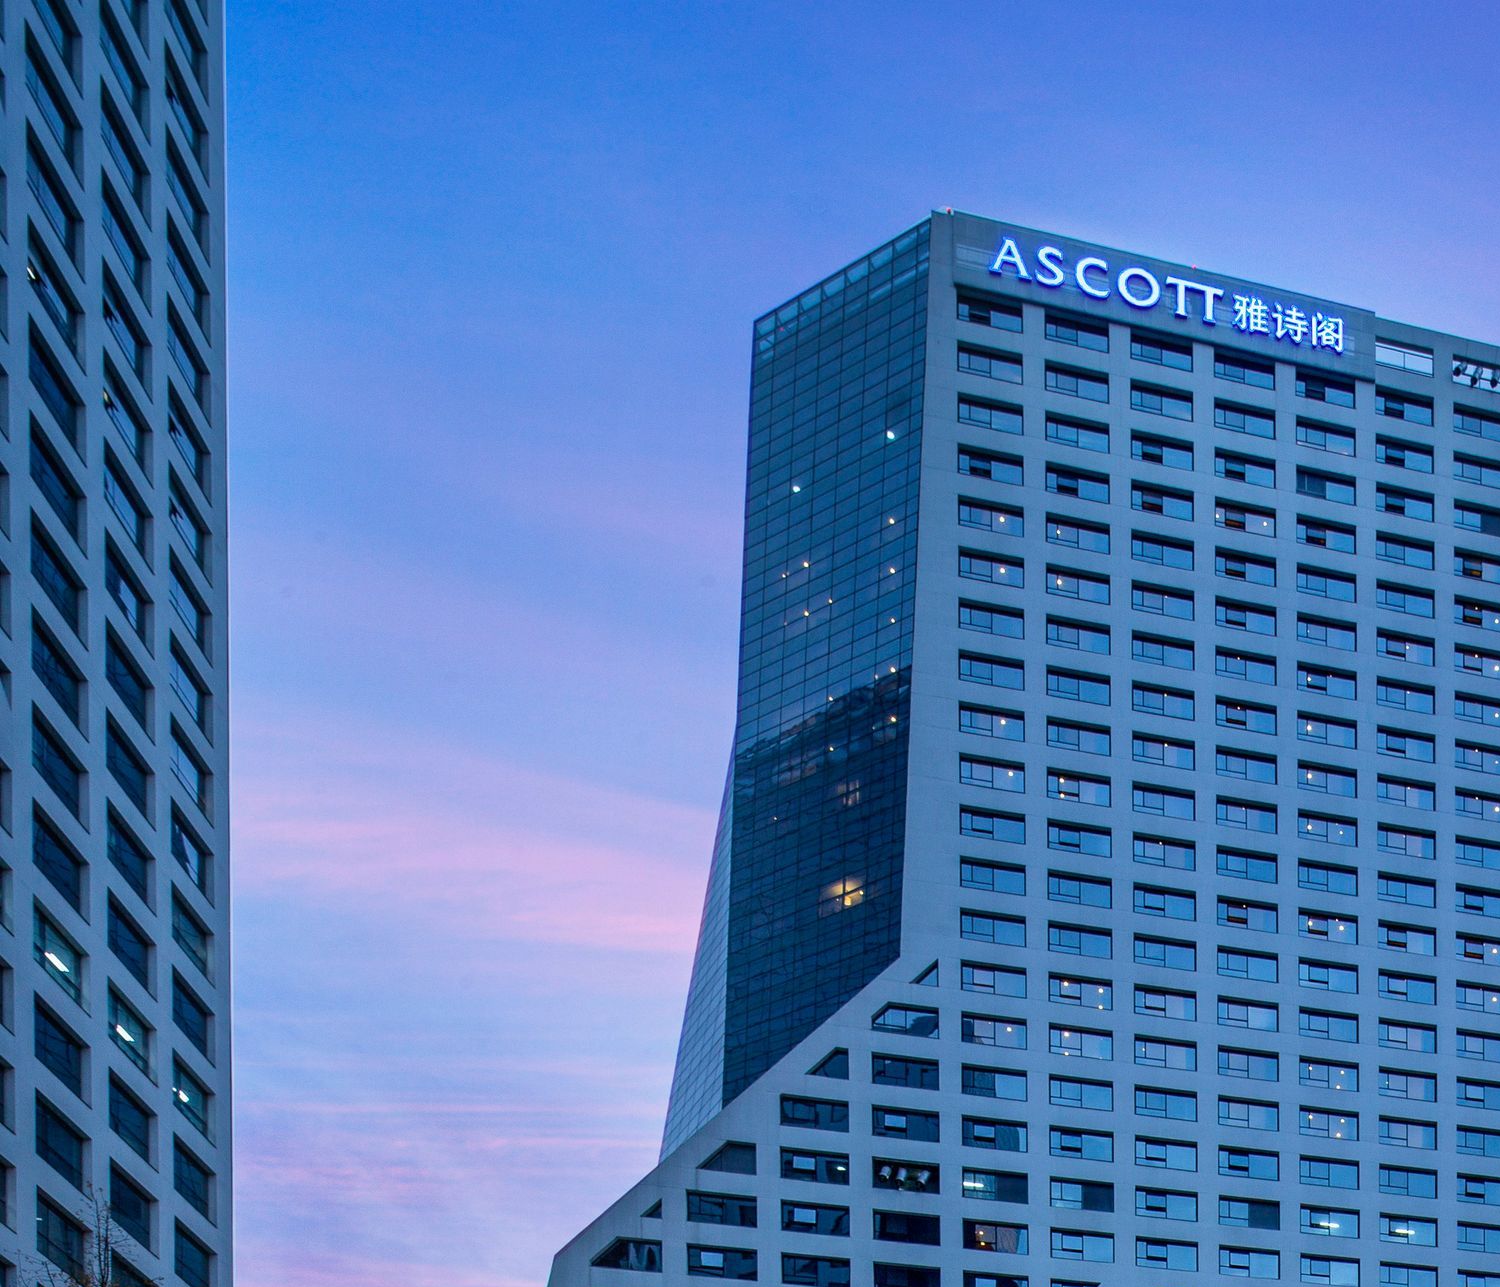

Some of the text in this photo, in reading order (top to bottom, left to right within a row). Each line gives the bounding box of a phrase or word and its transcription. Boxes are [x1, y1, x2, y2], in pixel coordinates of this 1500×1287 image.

[989, 237, 1345, 354] ASCOTT 雅诗阁
